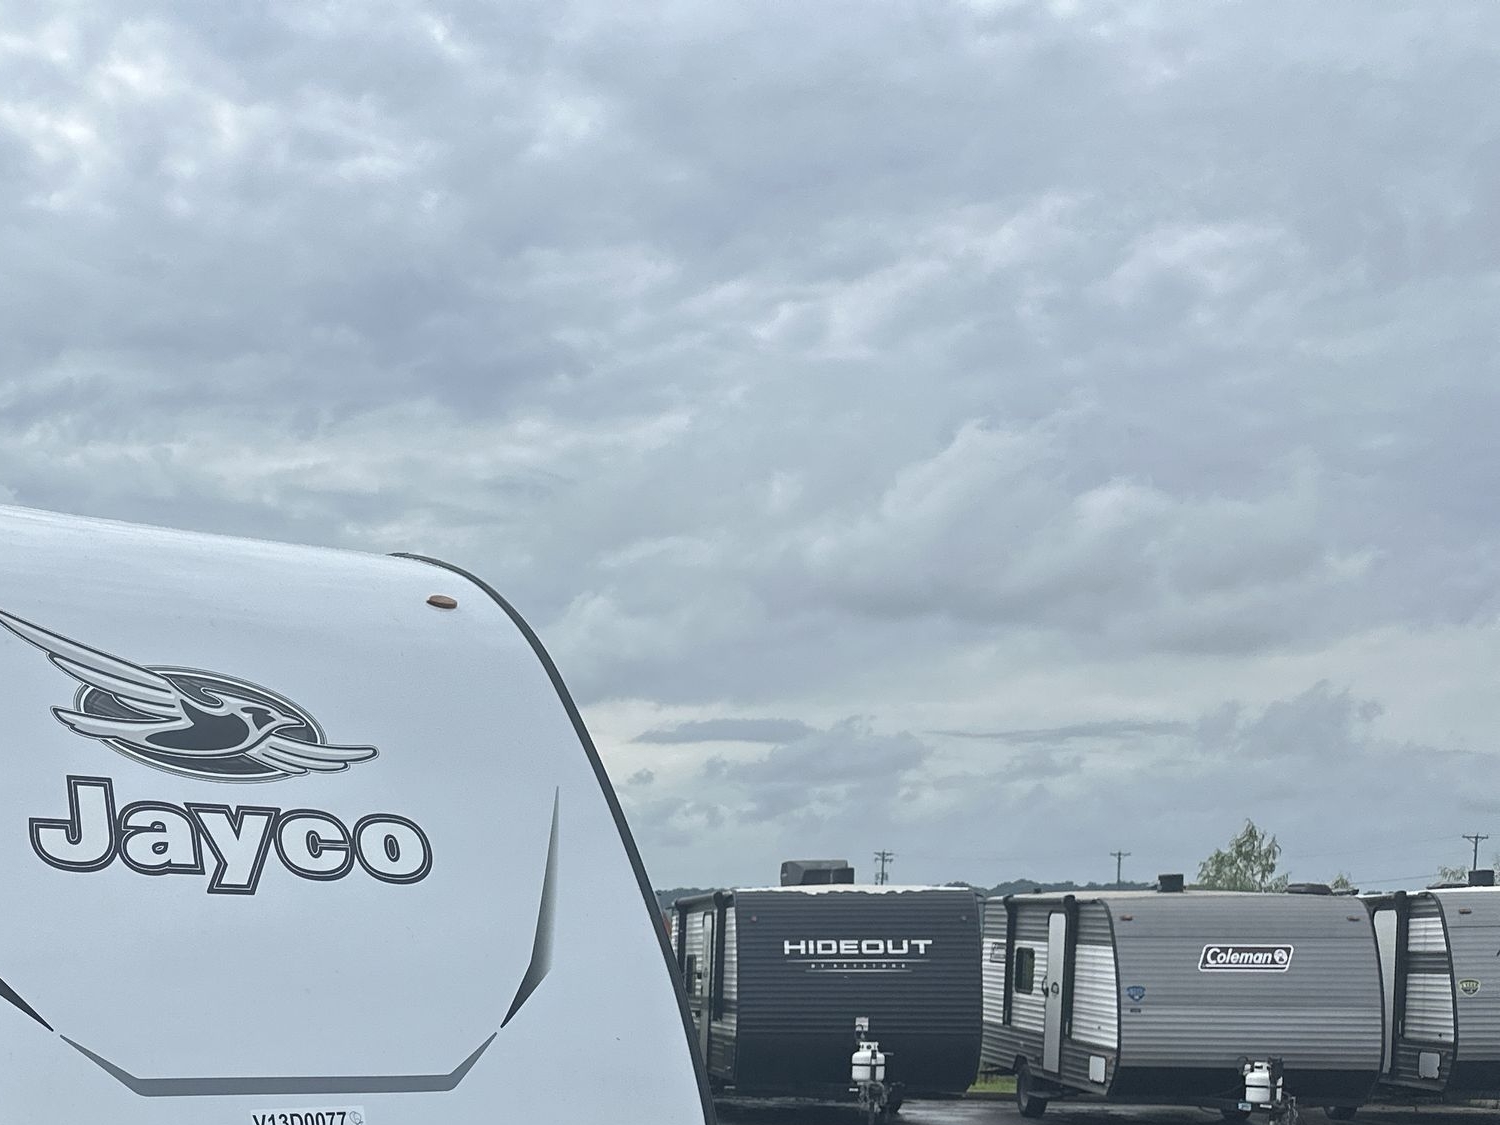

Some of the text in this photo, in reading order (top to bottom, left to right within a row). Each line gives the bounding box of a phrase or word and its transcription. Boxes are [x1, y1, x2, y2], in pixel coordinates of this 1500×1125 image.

[28, 774, 433, 896] Jayco
[783, 939, 933, 955] HIDEOUT
[1206, 947, 1273, 965] Coleman
